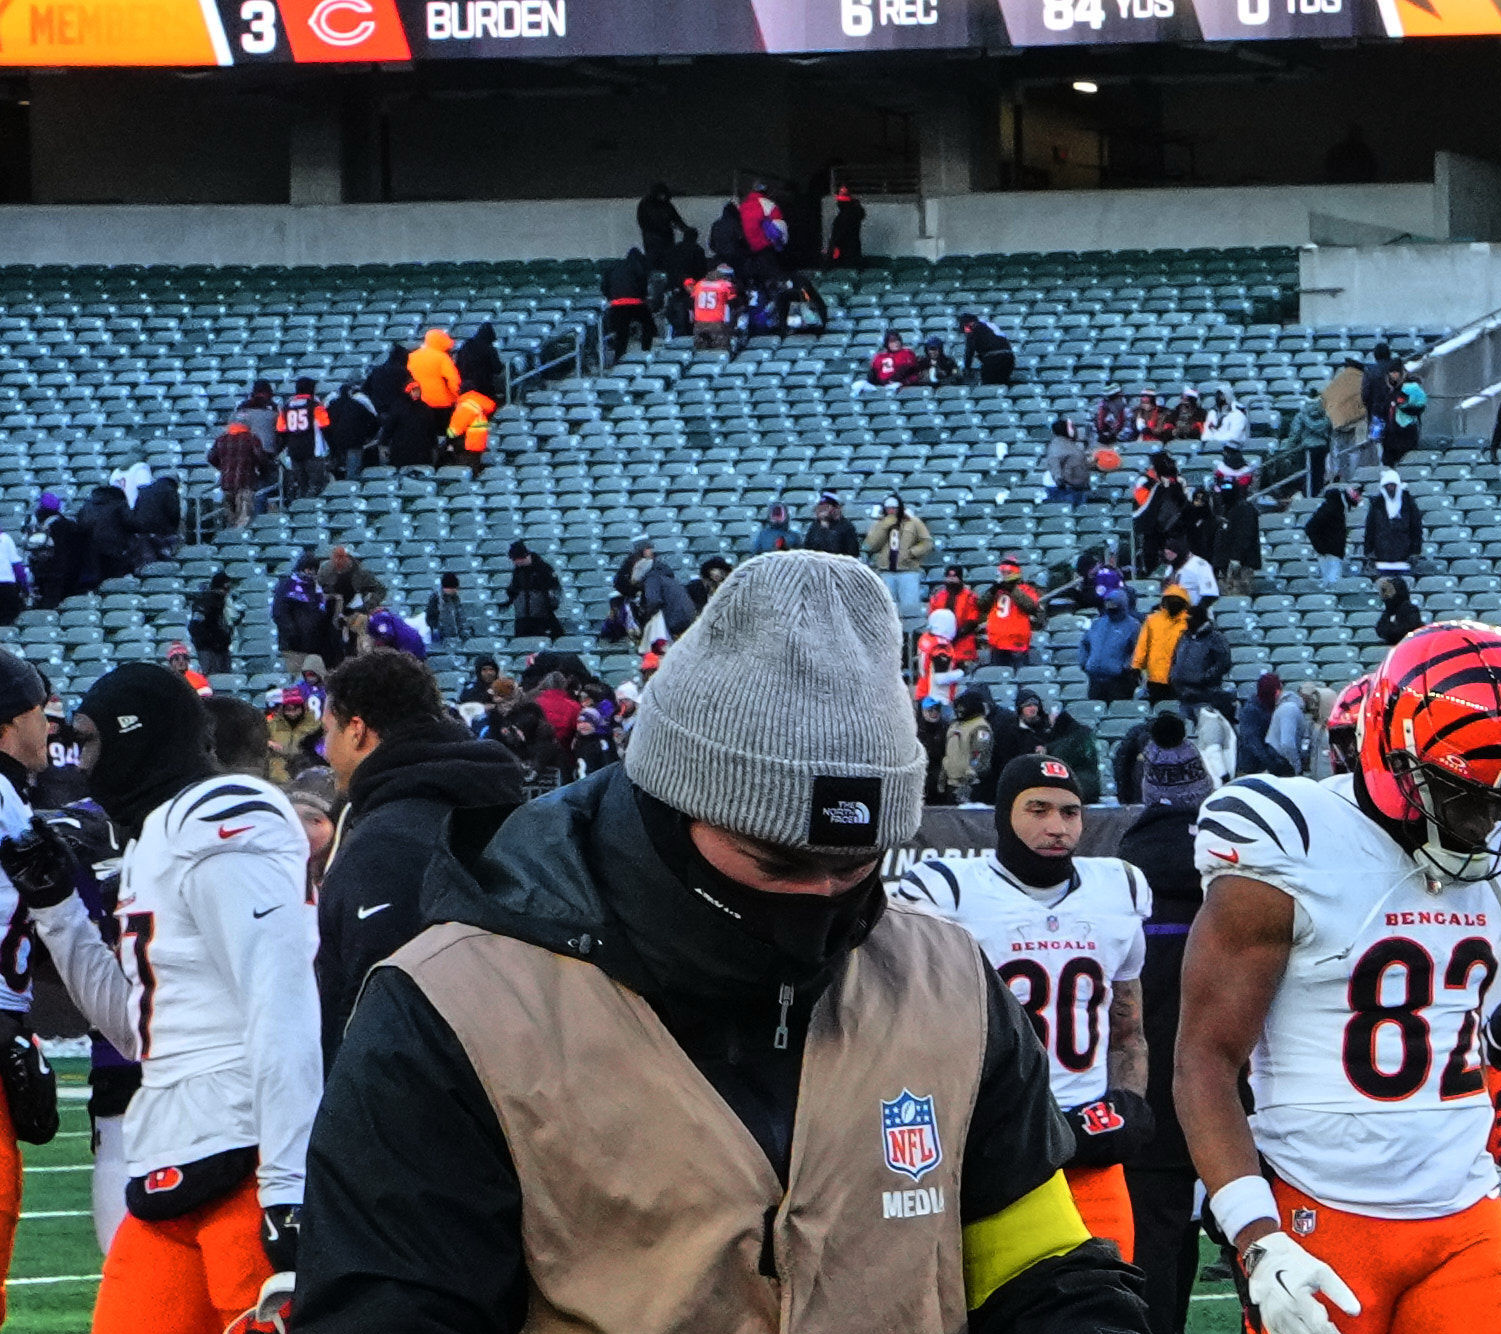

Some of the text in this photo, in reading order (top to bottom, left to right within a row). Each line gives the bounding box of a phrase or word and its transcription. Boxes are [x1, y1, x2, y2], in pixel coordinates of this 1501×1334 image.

[241, 0, 277, 53] 3
[427, 2, 566, 39] BURDEN
[841, 0, 873, 36] 6
[879, 0, 938, 25] REC
[1043, 0, 1107, 30] 84
[1384, 912, 1487, 927] BENGALS
[1010, 940, 1097, 952] BENGALS
[1341, 936, 1499, 1103] 82
[888, 1128, 934, 1168] NFL
